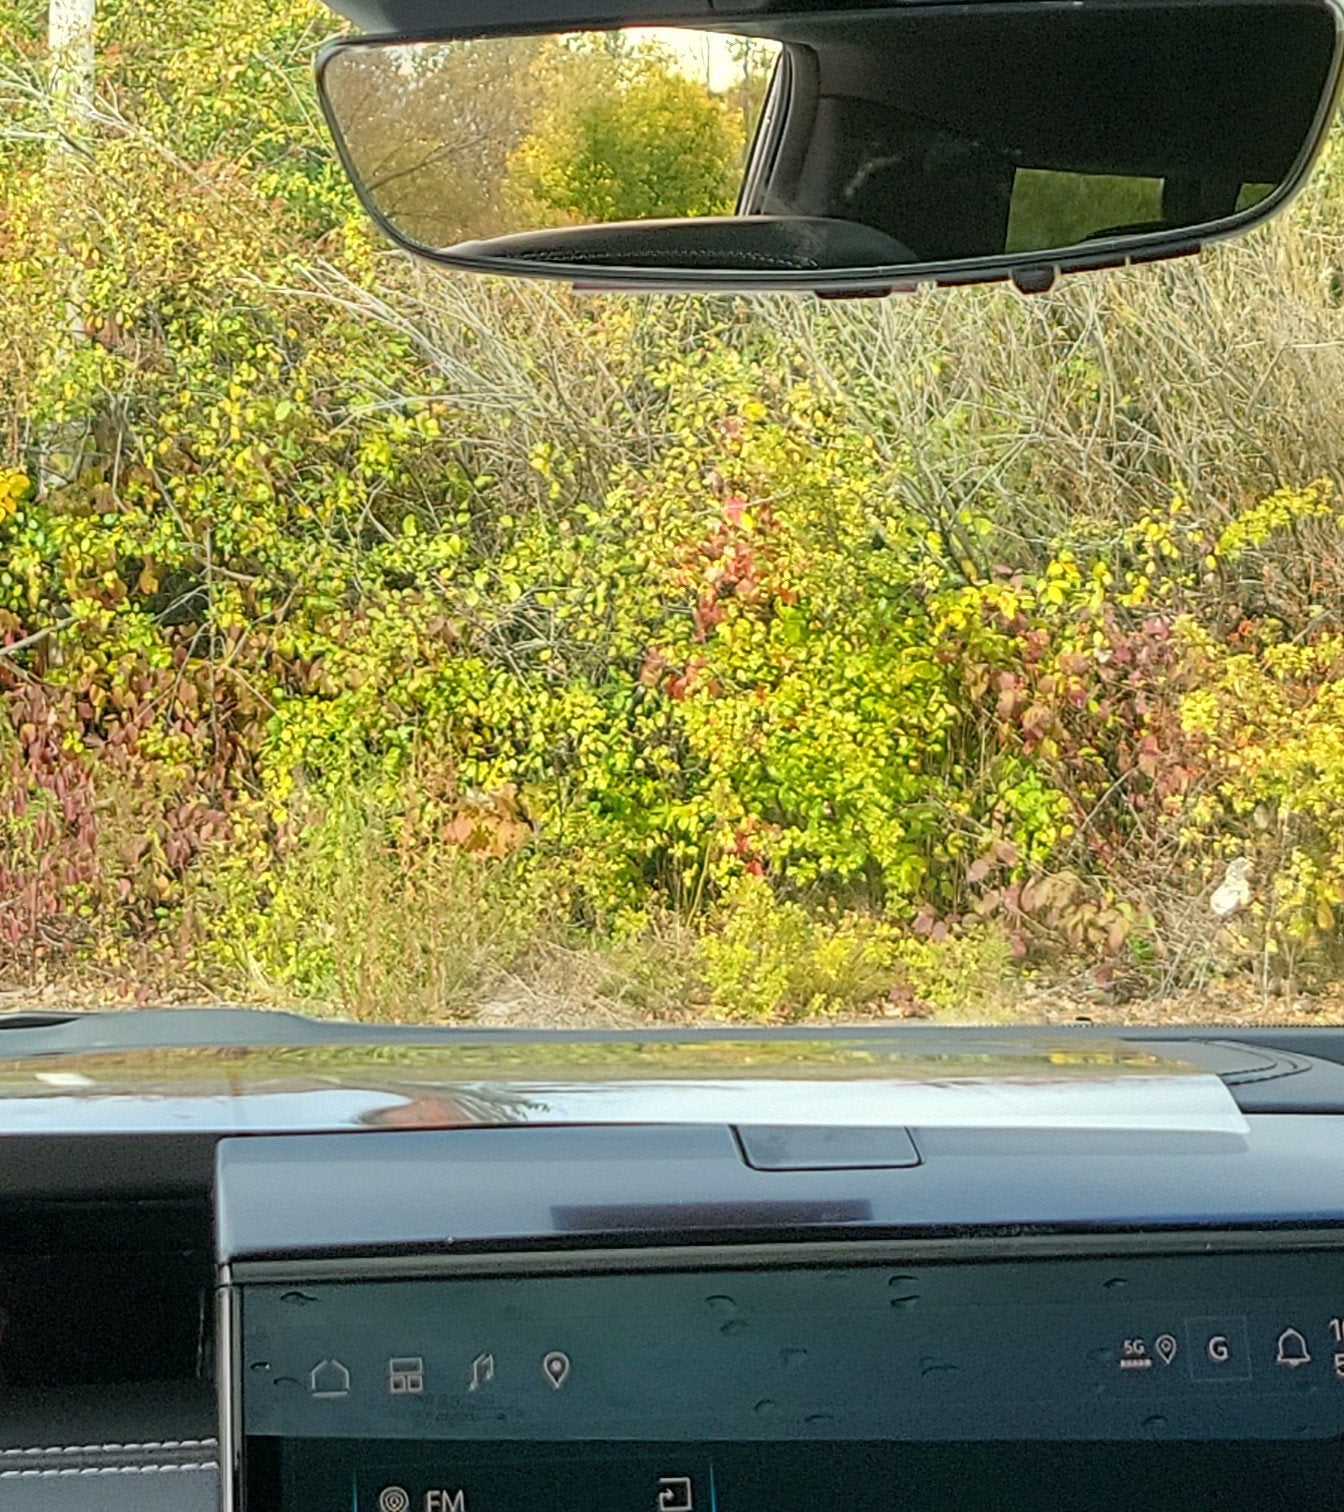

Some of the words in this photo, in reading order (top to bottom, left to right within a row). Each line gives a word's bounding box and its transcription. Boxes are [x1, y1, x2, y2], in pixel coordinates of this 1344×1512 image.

[1124, 1339, 1145, 1355] 5G
[1208, 1336, 1229, 1361] G
[426, 1489, 465, 1512] FM
